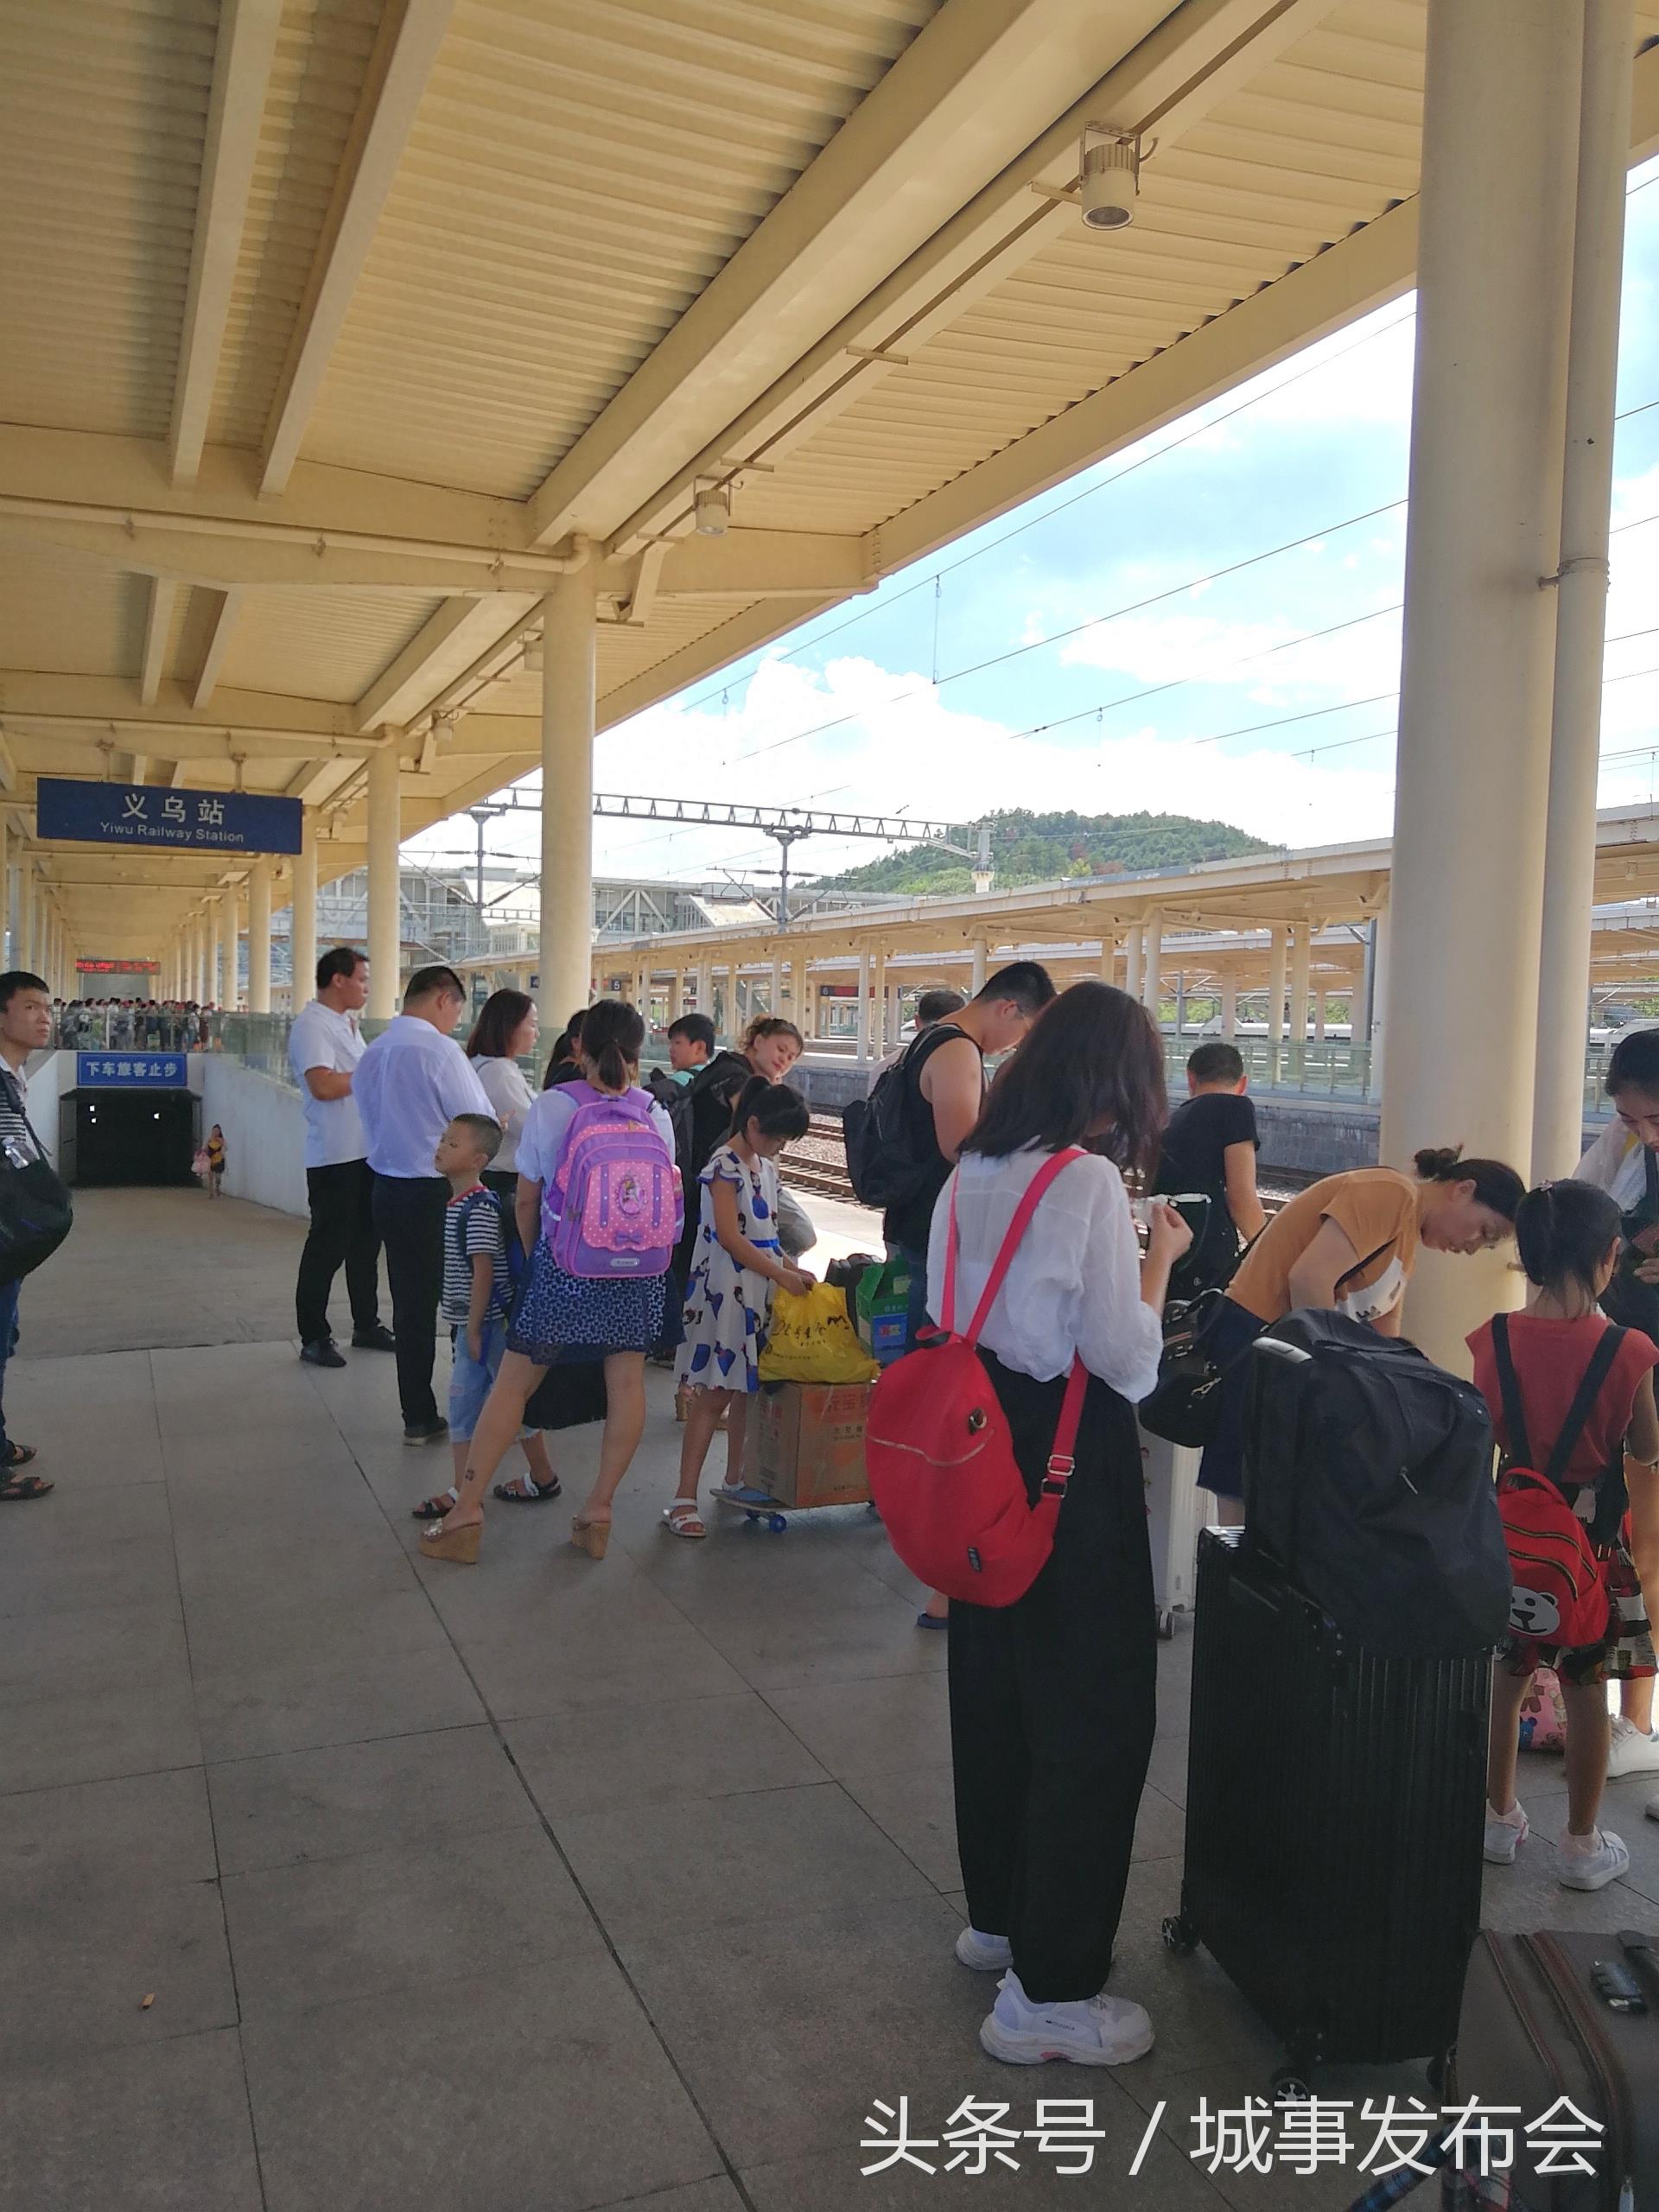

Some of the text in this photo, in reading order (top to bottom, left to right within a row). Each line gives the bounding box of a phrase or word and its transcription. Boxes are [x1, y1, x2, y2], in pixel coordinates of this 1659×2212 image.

[122, 793, 225, 825] 义乌站
[100, 822, 245, 843] Yiwu Railway Station
[86, 1061, 177, 1077] 下车旅客止步
